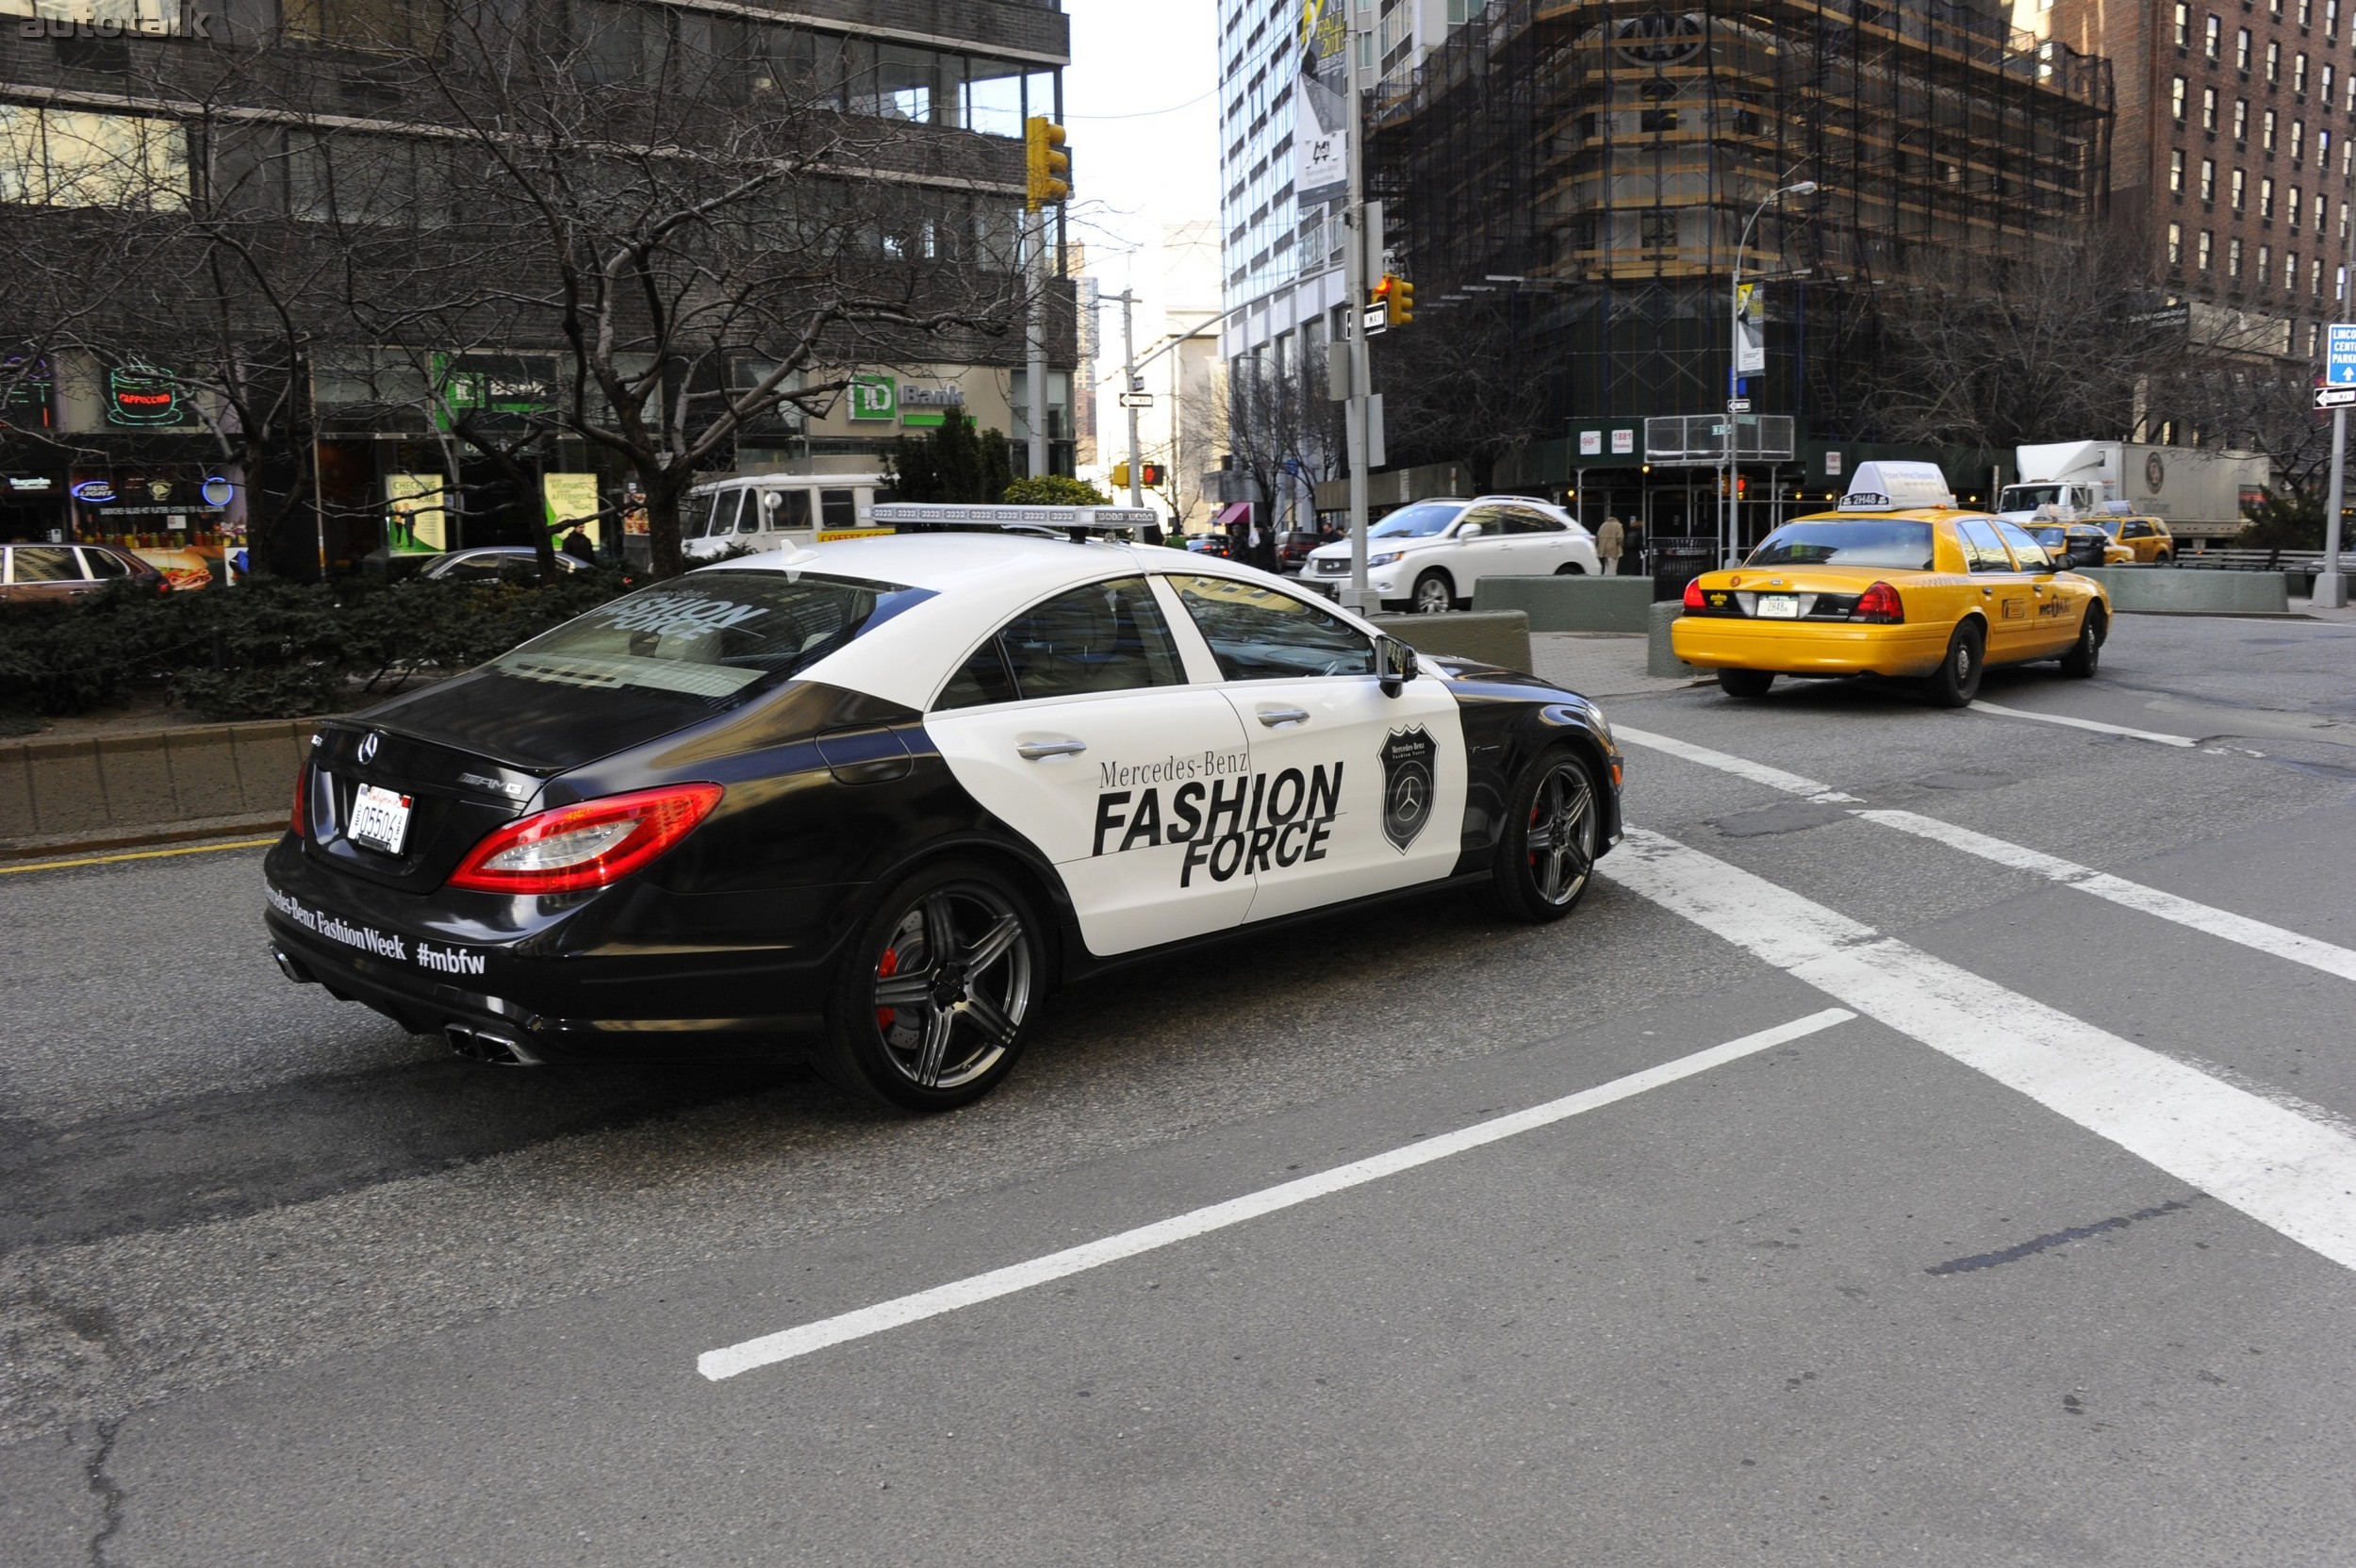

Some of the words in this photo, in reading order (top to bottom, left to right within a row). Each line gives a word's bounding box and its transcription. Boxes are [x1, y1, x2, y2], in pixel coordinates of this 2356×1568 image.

[1316, 11, 1344, 40] FALL
[857, 384, 892, 410] TD
[901, 386, 964, 405] Bank
[2320, 394, 2332, 403] ONE
[1853, 494, 1877, 504] 2H48
[594, 614, 715, 640] FORCE
[1392, 742, 1425, 753] Mercedes-Benz
[1099, 751, 1248, 788] Mercedes-Benz
[1092, 761, 1344, 857] FASHION
[359, 805, 398, 843] 05506
[1180, 814, 1336, 888] FORCE
[316, 910, 407, 960] FashionWeek
[416, 942, 485, 975] #mbfw
